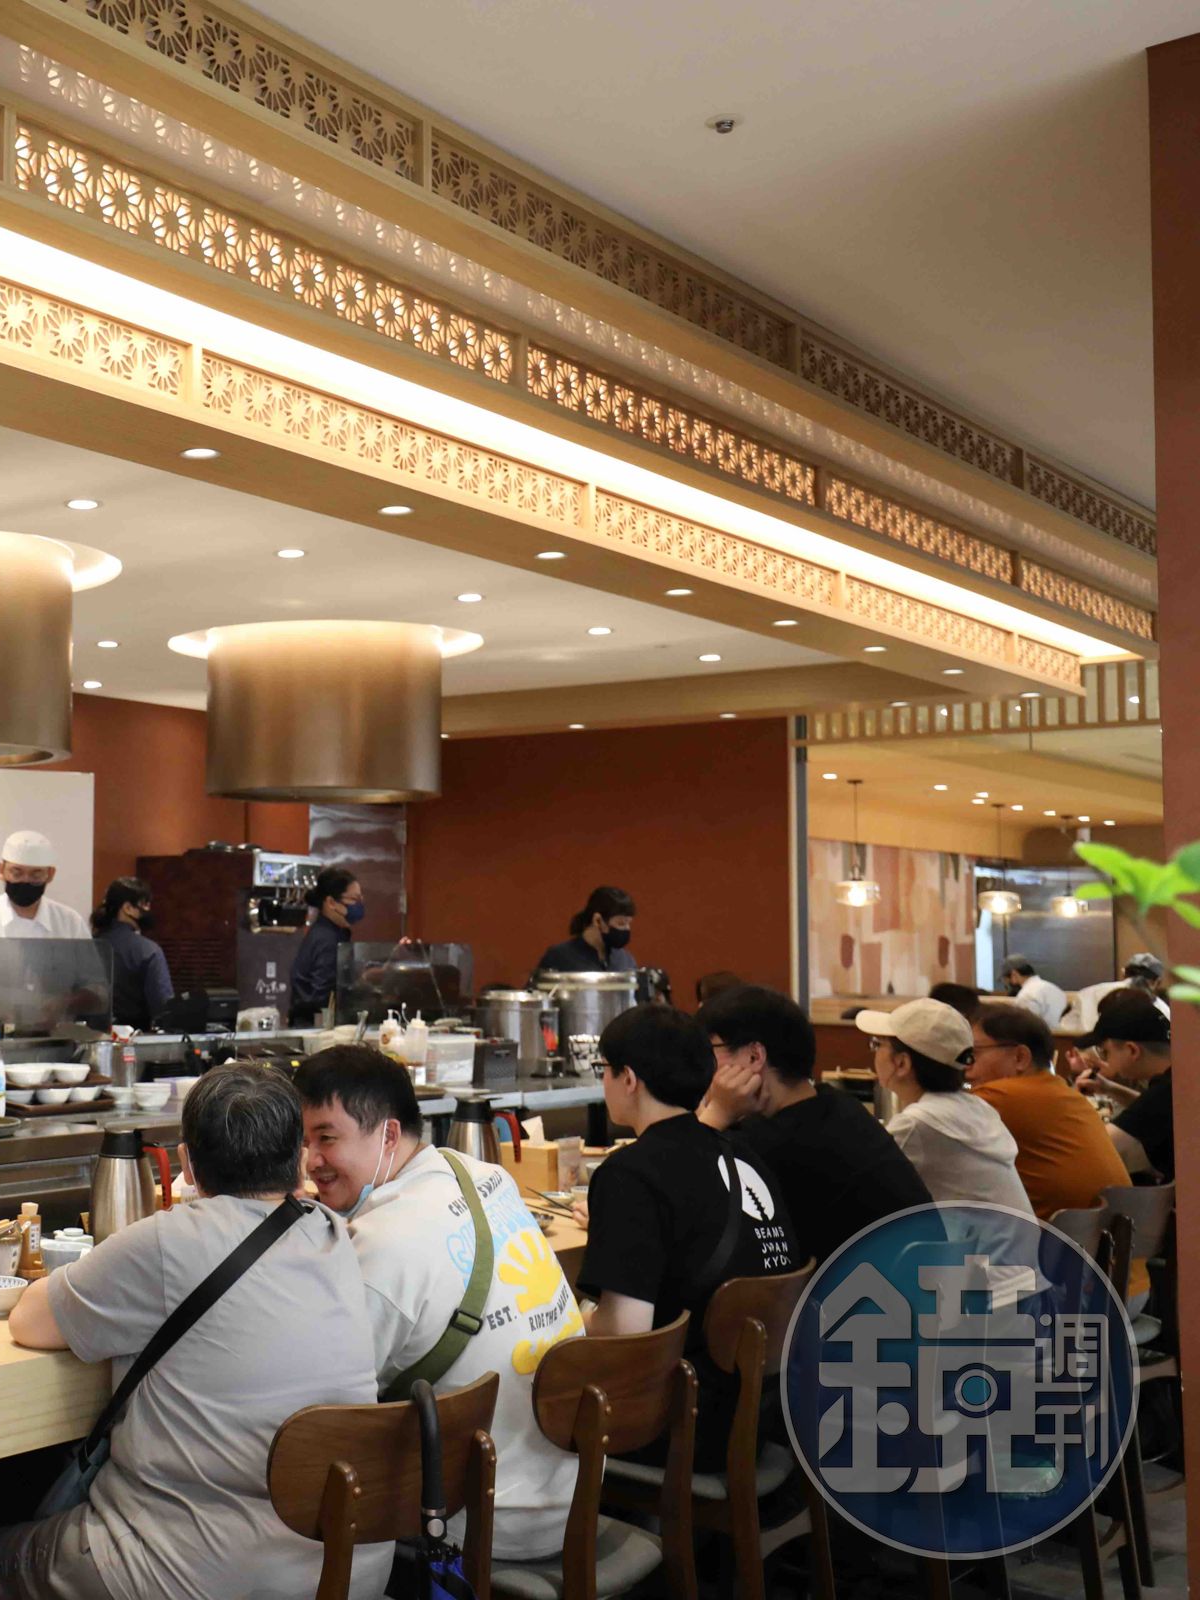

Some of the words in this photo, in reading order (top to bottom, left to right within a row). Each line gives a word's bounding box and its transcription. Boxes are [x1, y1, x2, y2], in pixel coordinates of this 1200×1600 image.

[754, 1226, 785, 1239] BEAMS
[486, 1305, 518, 1331] EST.
[528, 1313, 545, 1332] RIDE
[545, 1307, 558, 1327] THE
